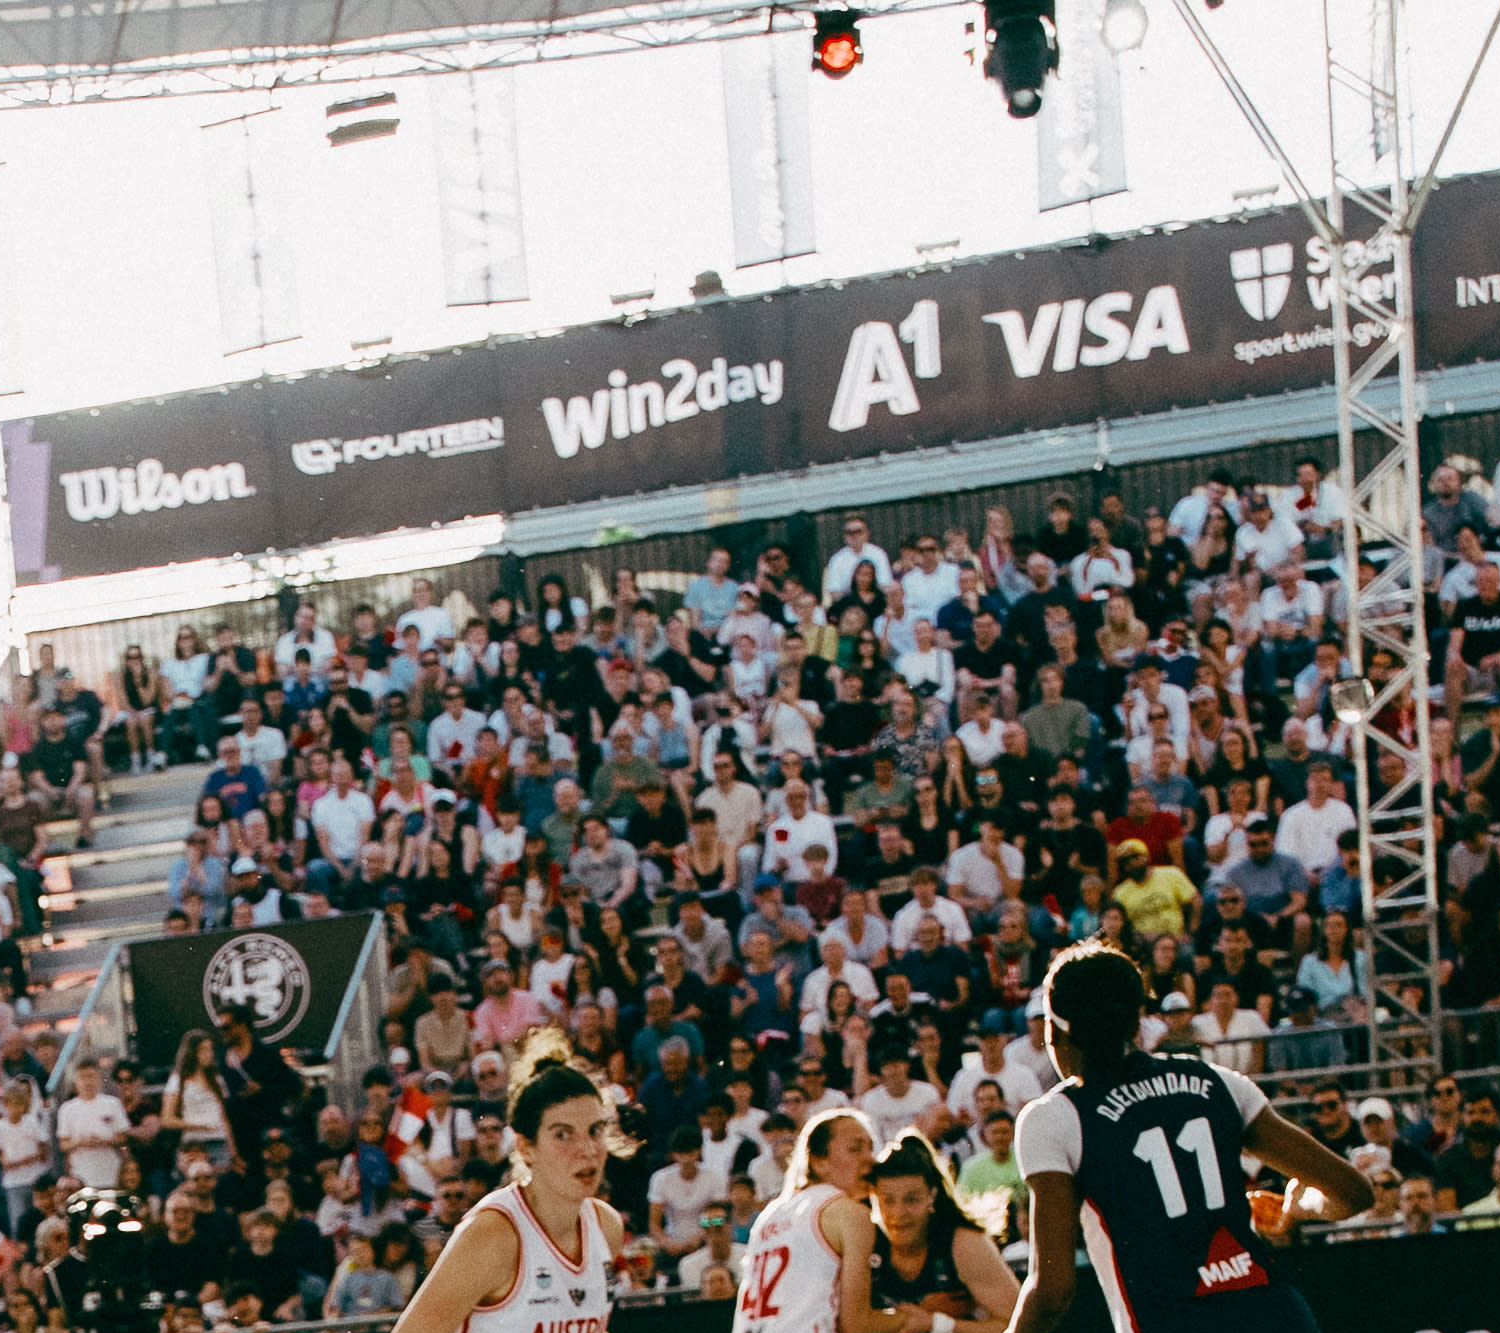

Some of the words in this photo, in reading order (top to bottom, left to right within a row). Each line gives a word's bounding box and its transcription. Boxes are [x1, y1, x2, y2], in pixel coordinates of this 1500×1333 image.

[828, 299, 942, 434] A1
[981, 284, 1190, 379] VISA
[342, 416, 504, 465] FOURTEEN
[59, 457, 257, 523] Wilson
[1132, 1116, 1226, 1220] 11
[1198, 1251, 1253, 1288] MAIF
